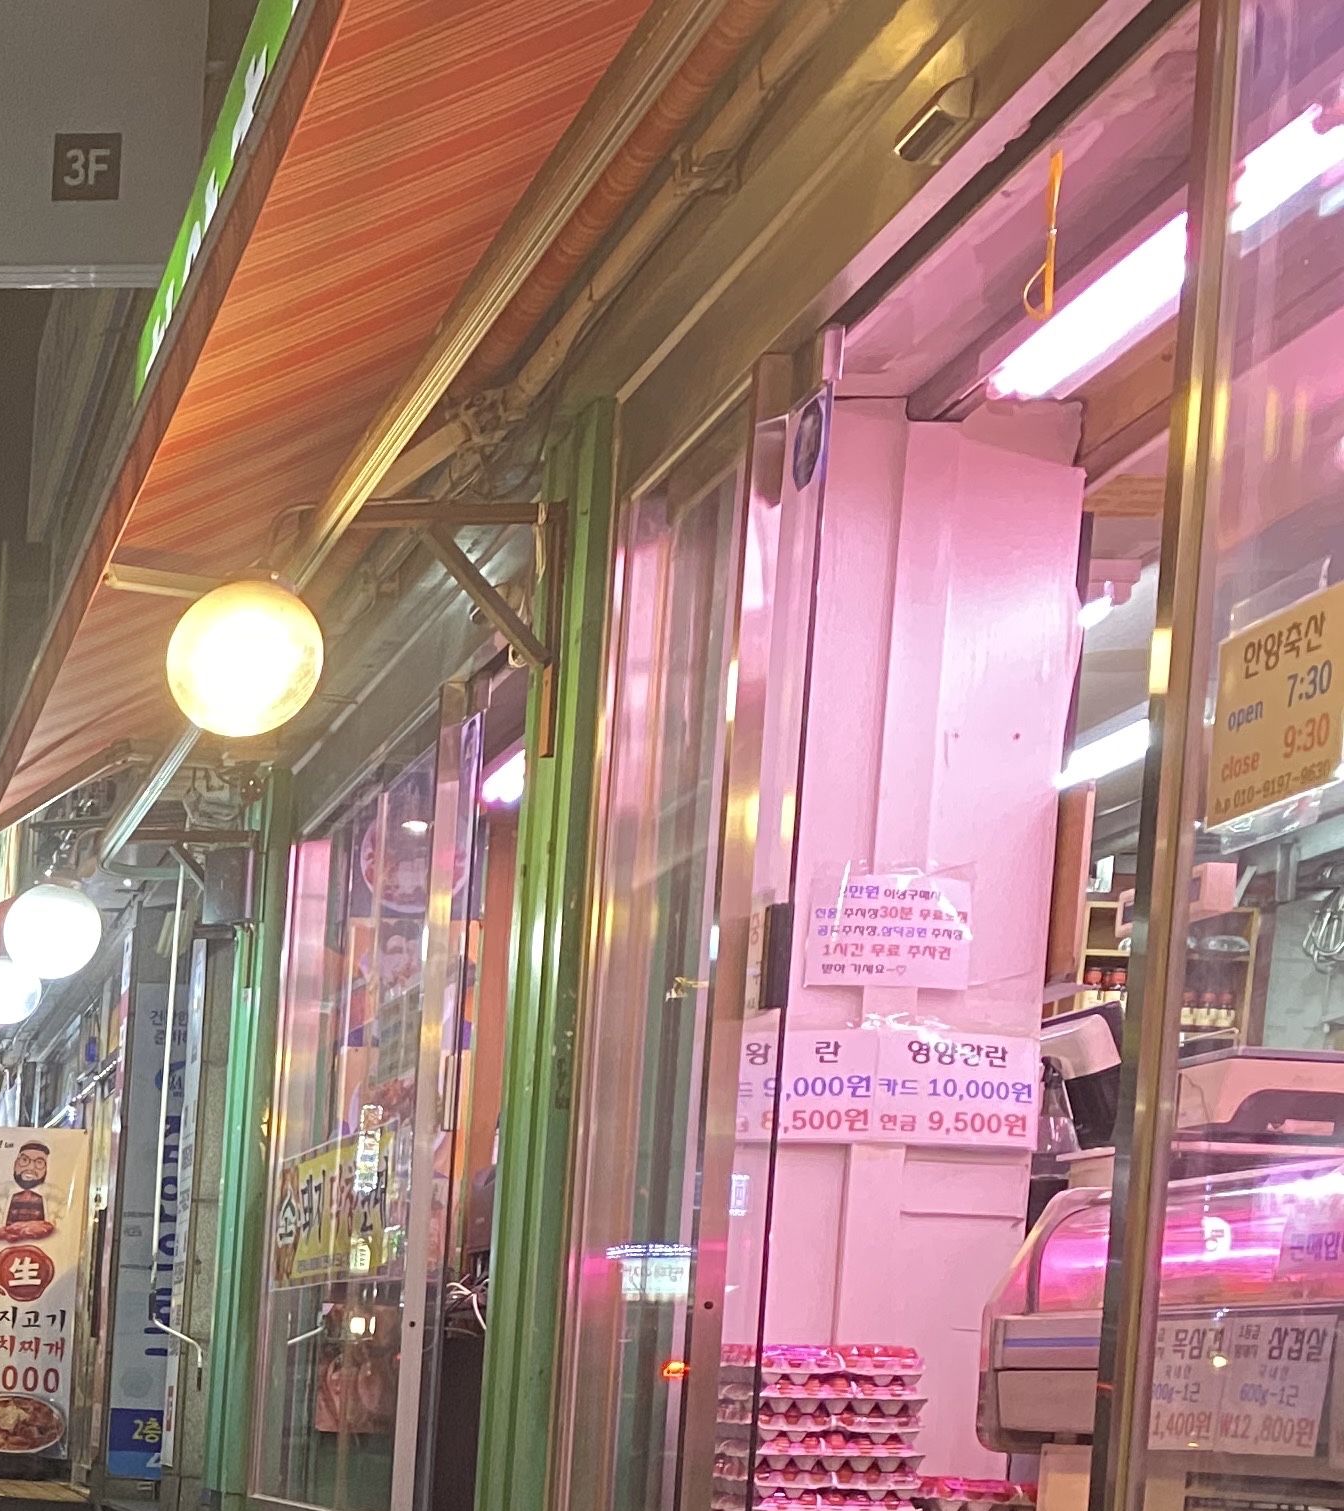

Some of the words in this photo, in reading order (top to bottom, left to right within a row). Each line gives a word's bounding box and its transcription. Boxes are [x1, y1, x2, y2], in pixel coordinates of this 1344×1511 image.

[63, 148, 111, 187] 3F
[1243, 611, 1327, 680] 안양축산
[1227, 699, 1263, 732] open
[1287, 660, 1333, 709] 7:30
[1221, 750, 1260, 783] close
[1283, 712, 1331, 759] 9:30
[822, 942, 864, 958] 1시간
[870, 943, 901, 958] 무료
[907, 945, 952, 961] 주차권
[745, 1042, 773, 1066] 왕
[814, 1040, 843, 1064] 란
[763, 1074, 872, 1102] 9,000원
[878, 1077, 919, 1097] 카드
[927, 1077, 1033, 1104] 10,000원
[760, 1108, 870, 1135] 8,500원
[927, 1110, 1028, 1138] 9,500원
[8, 1256, 42, 1287] 生
[1268, 1327, 1329, 1362] 삼겹살
[131, 1416, 162, 1444] 2층
